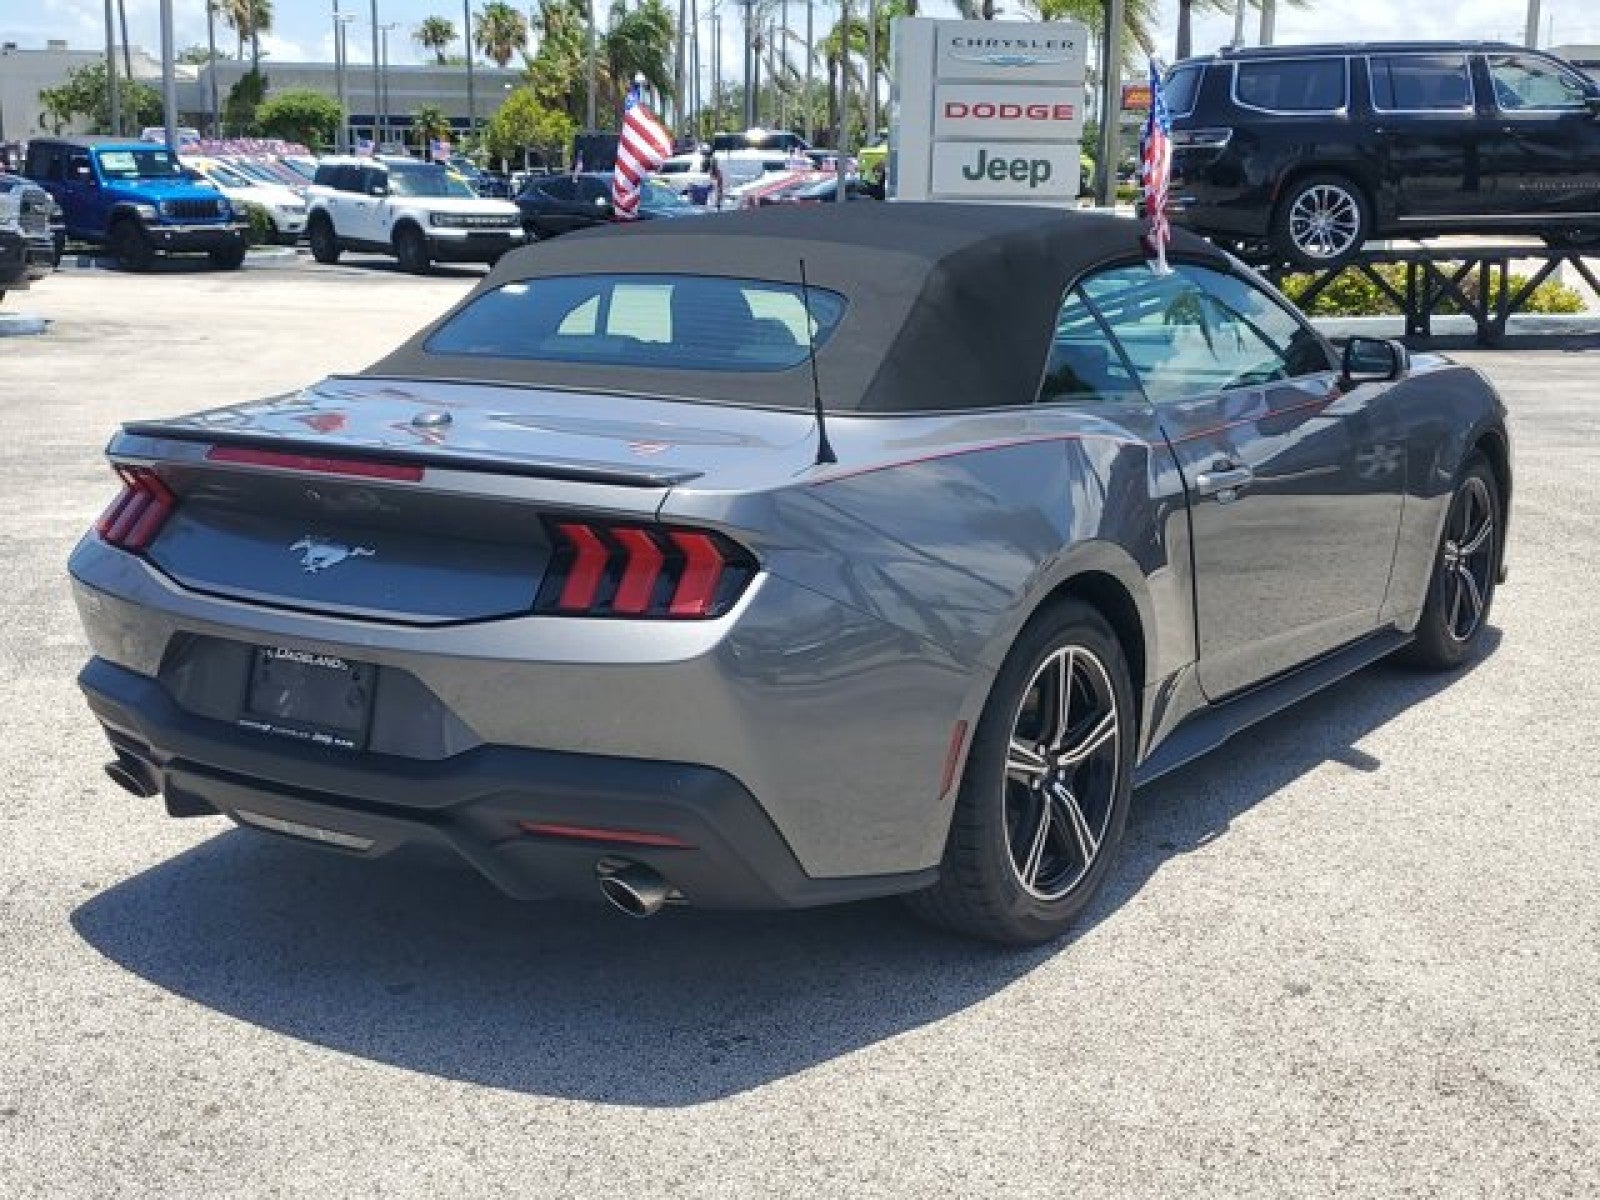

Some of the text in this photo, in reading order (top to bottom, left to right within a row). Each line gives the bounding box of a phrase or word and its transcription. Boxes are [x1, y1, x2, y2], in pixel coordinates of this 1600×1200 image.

[951, 37, 1074, 50] CHRYSLER
[944, 102, 1074, 120] DODGE
[962, 149, 1052, 188] Jeep
